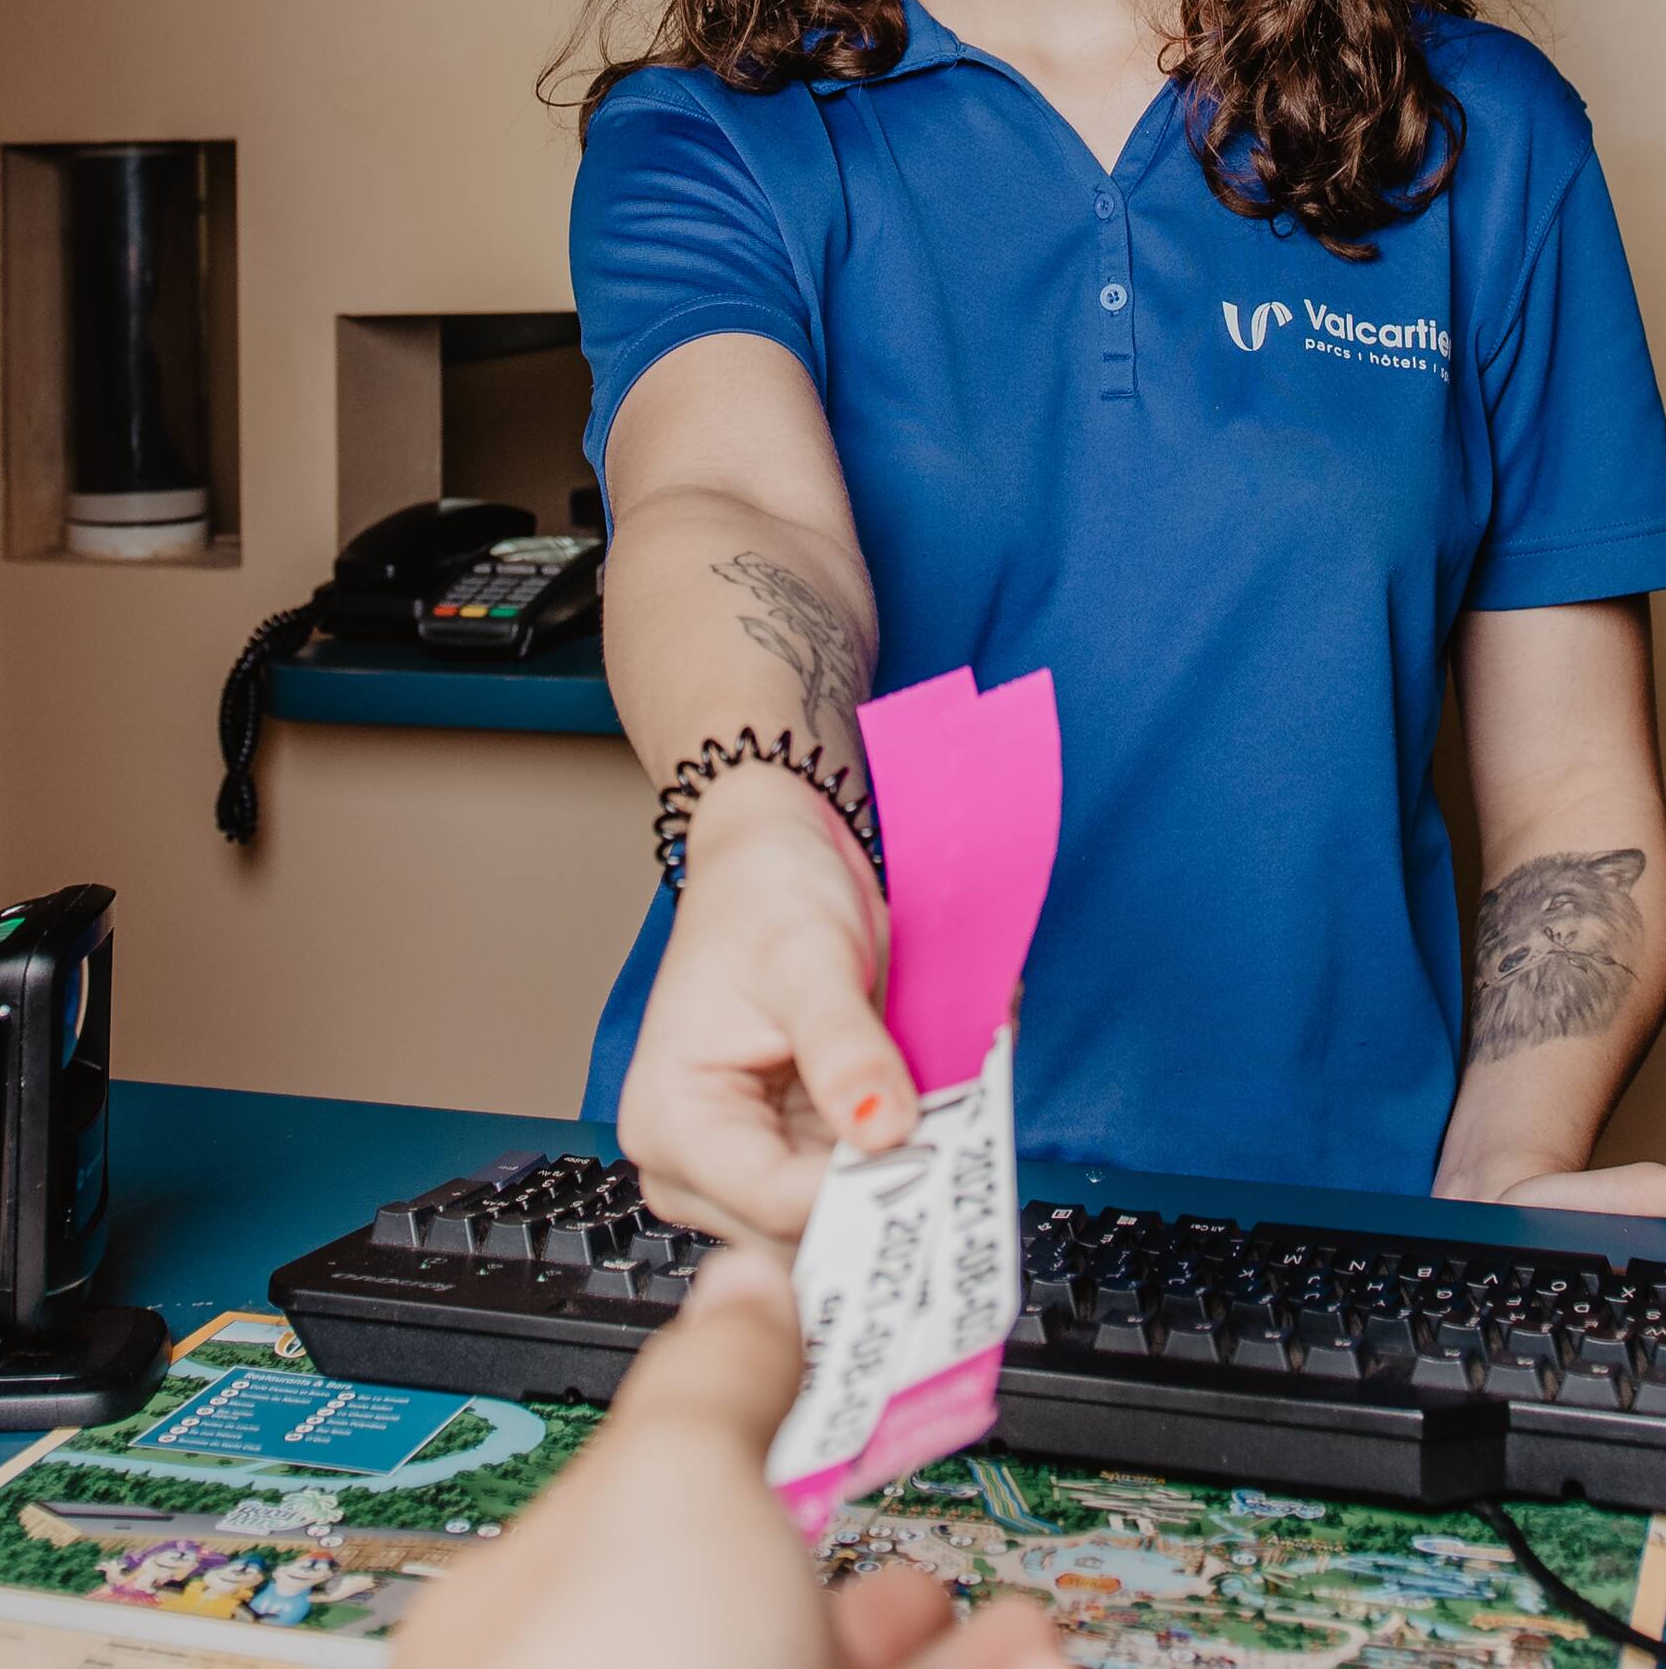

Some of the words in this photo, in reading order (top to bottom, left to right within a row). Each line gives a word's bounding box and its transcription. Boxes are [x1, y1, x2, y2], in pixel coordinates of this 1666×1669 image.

[1303, 298, 1451, 361] Valcartie
[1305, 337, 1351, 360] parcs
[1369, 351, 1427, 371] hôtels
[244, 1372, 311, 1388] Restaurants
